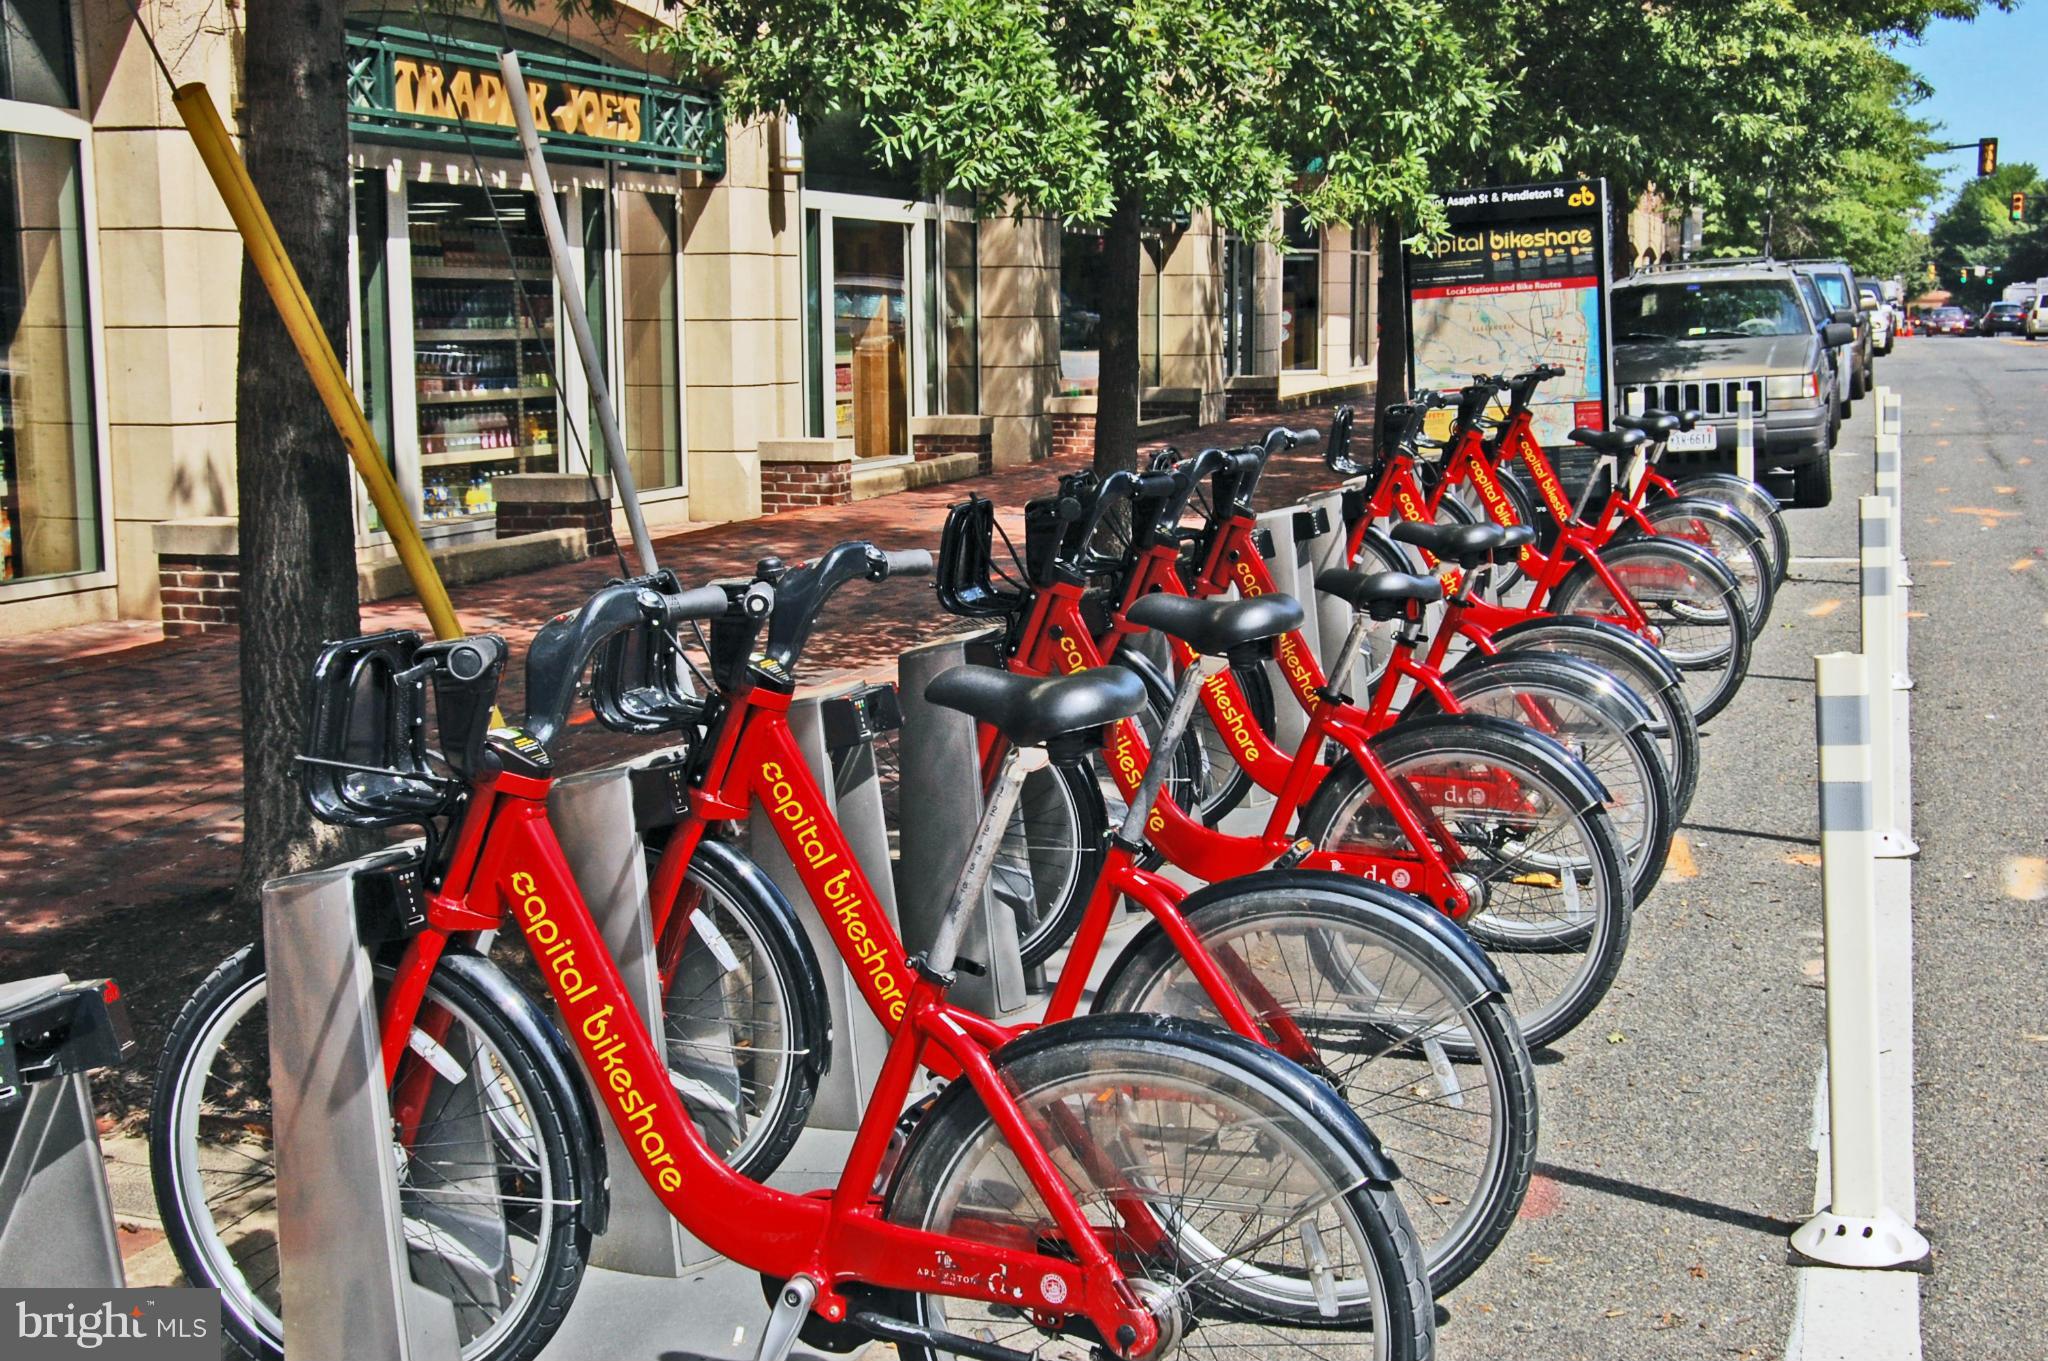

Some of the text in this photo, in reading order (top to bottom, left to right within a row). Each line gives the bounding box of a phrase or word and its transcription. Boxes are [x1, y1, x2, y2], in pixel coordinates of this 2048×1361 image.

[551, 82, 640, 142] JOE'S
[1447, 195, 1477, 206] Asaph
[1479, 194, 1488, 203] St
[1491, 193, 1499, 202] &
[1502, 189, 1551, 201] Pendleton
[1553, 187, 1564, 198] St
[1489, 228, 1593, 250] bikeshare
[1446, 281, 1562, 296] Local Stations and Bike Routes
[1470, 460, 1501, 503] capital
[1521, 441, 1548, 480] capital
[1541, 478, 1567, 523] bikesha
[761, 761, 838, 870] capital
[510, 871, 683, 1193] capital bikeshare
